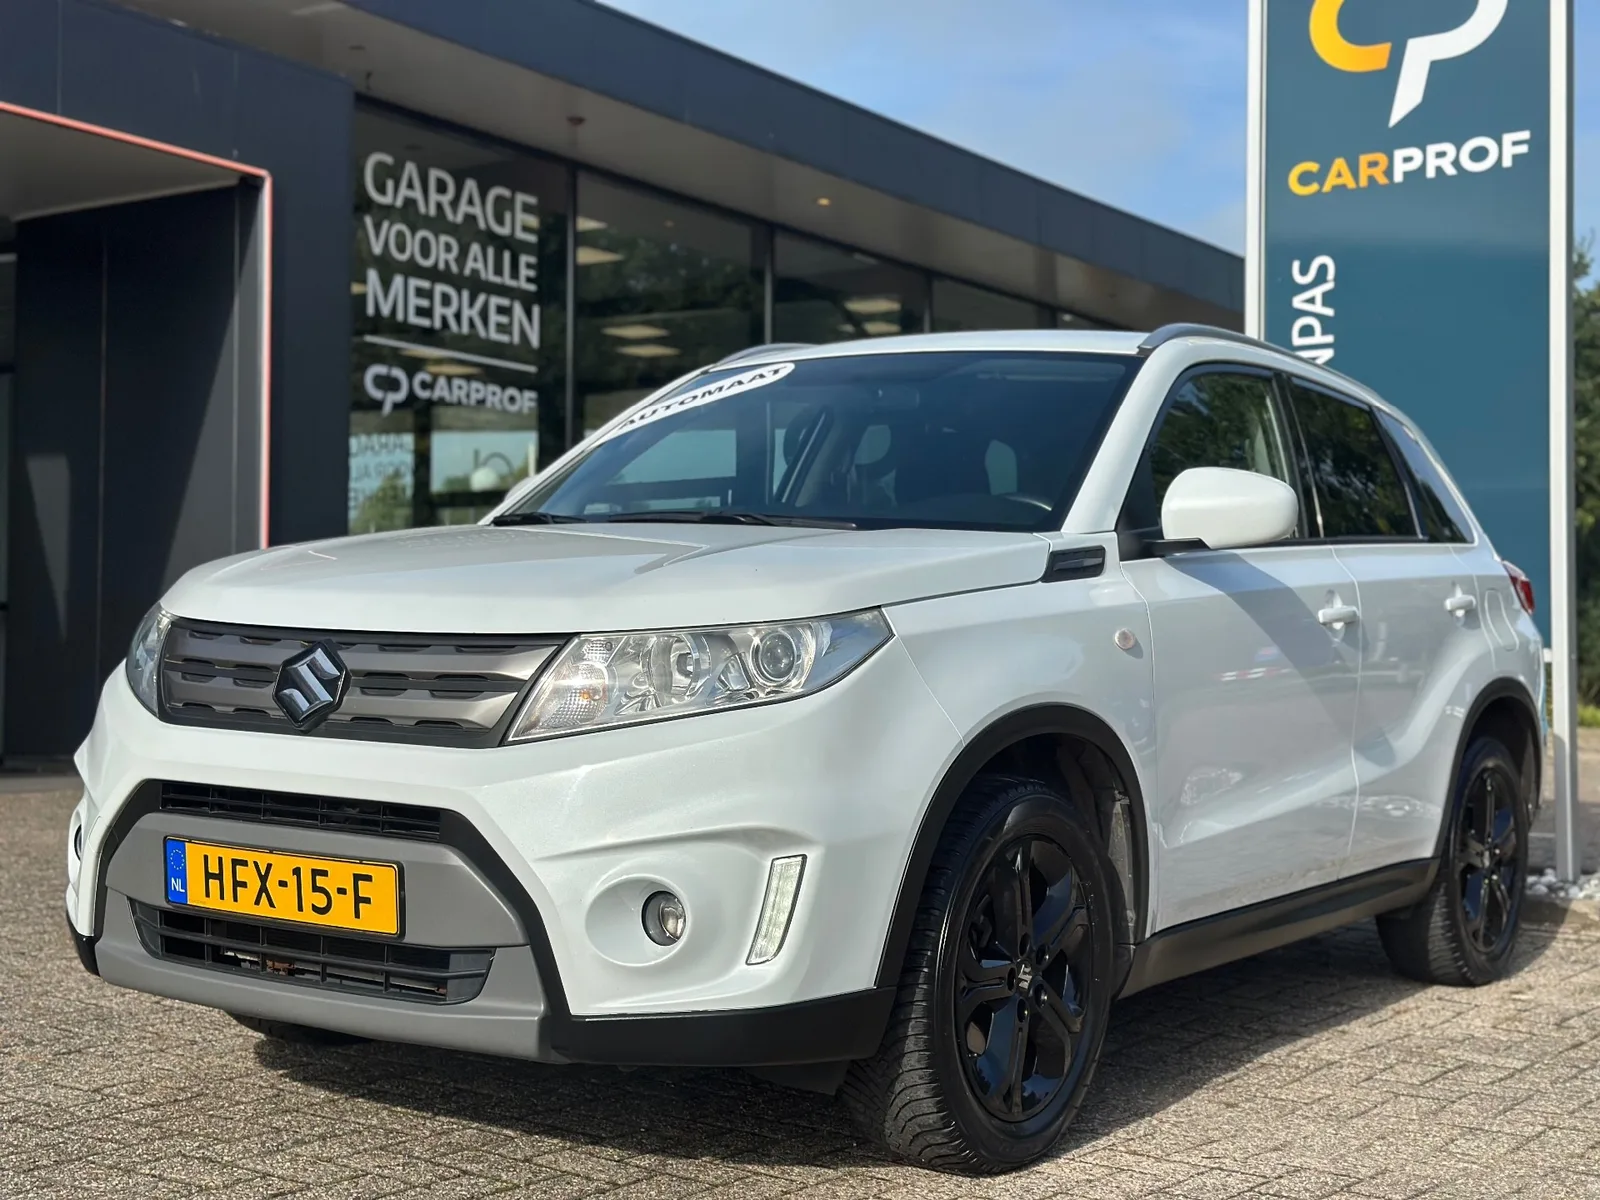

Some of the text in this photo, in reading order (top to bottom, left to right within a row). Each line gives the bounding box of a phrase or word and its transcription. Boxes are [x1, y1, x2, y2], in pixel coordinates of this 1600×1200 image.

[1288, 130, 1531, 195] CARPROF
[363, 151, 539, 243] GARAGE
[363, 214, 538, 292] VOOR ALLE
[366, 268, 541, 350] MERKEN
[412, 372, 538, 414] CARPROF
[617, 365, 788, 430] AUTOMAAT
[171, 854, 373, 919] NL HFX-15-F
